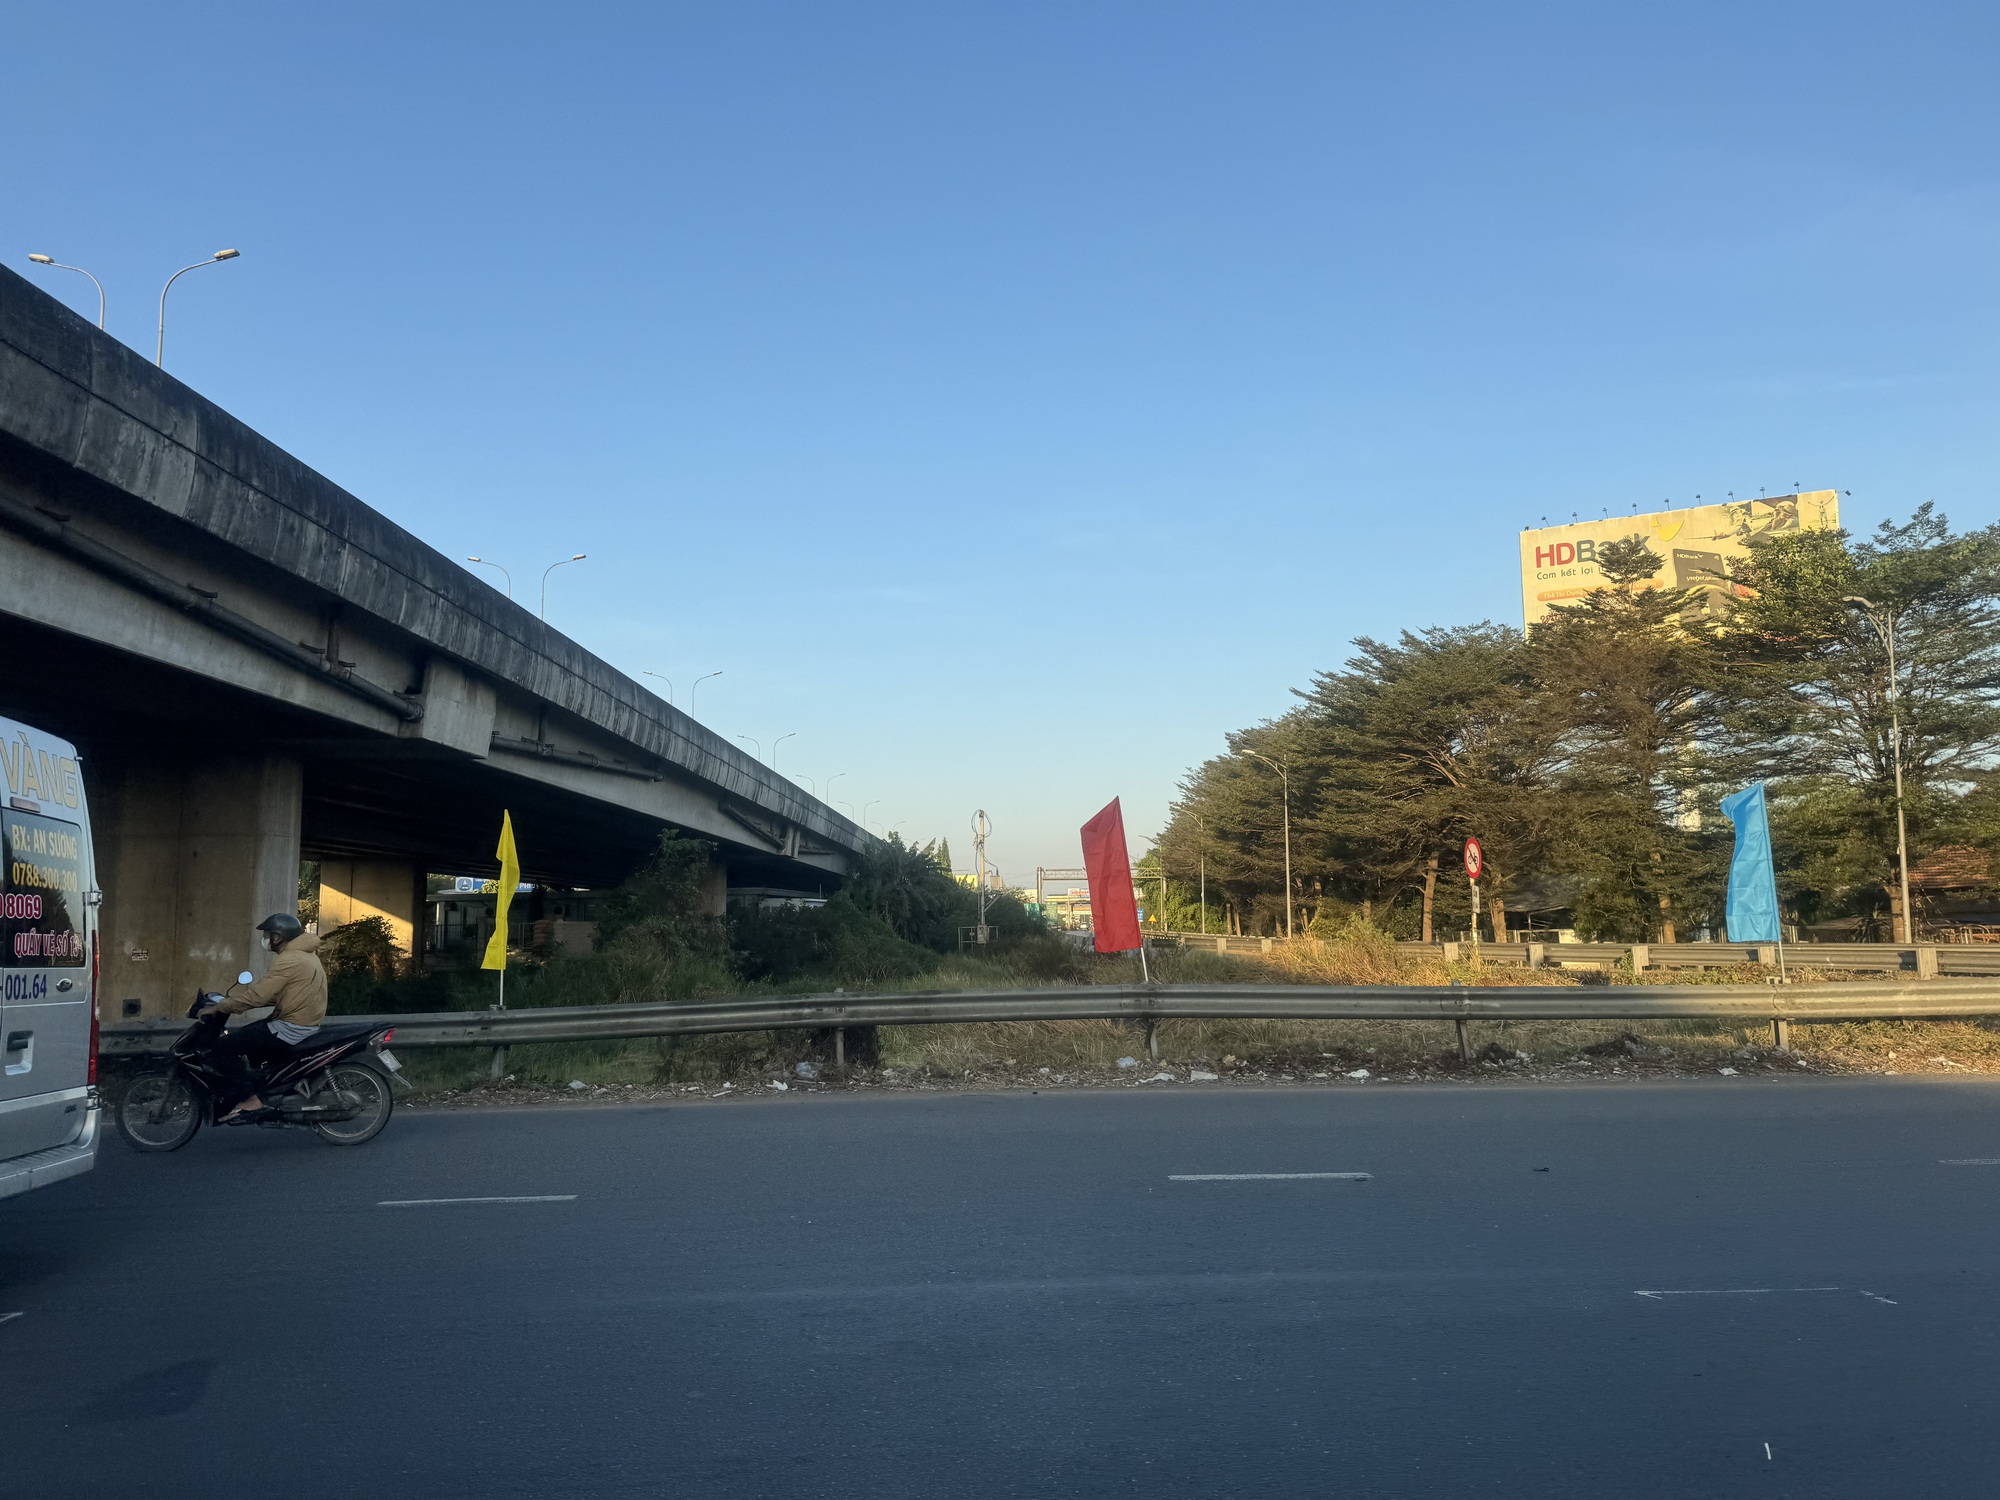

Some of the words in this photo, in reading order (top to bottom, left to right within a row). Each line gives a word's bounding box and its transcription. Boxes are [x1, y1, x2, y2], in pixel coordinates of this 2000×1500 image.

[1536, 571, 1556, 580] Cam
[1560, 566, 1576, 577] kết
[0, 730, 78, 809] VÀNG
[11, 824, 31, 852] BX:
[33, 828, 47, 855] AN
[48, 829, 78, 860] SƯƠNG
[56, 929, 69, 957] SỐ
